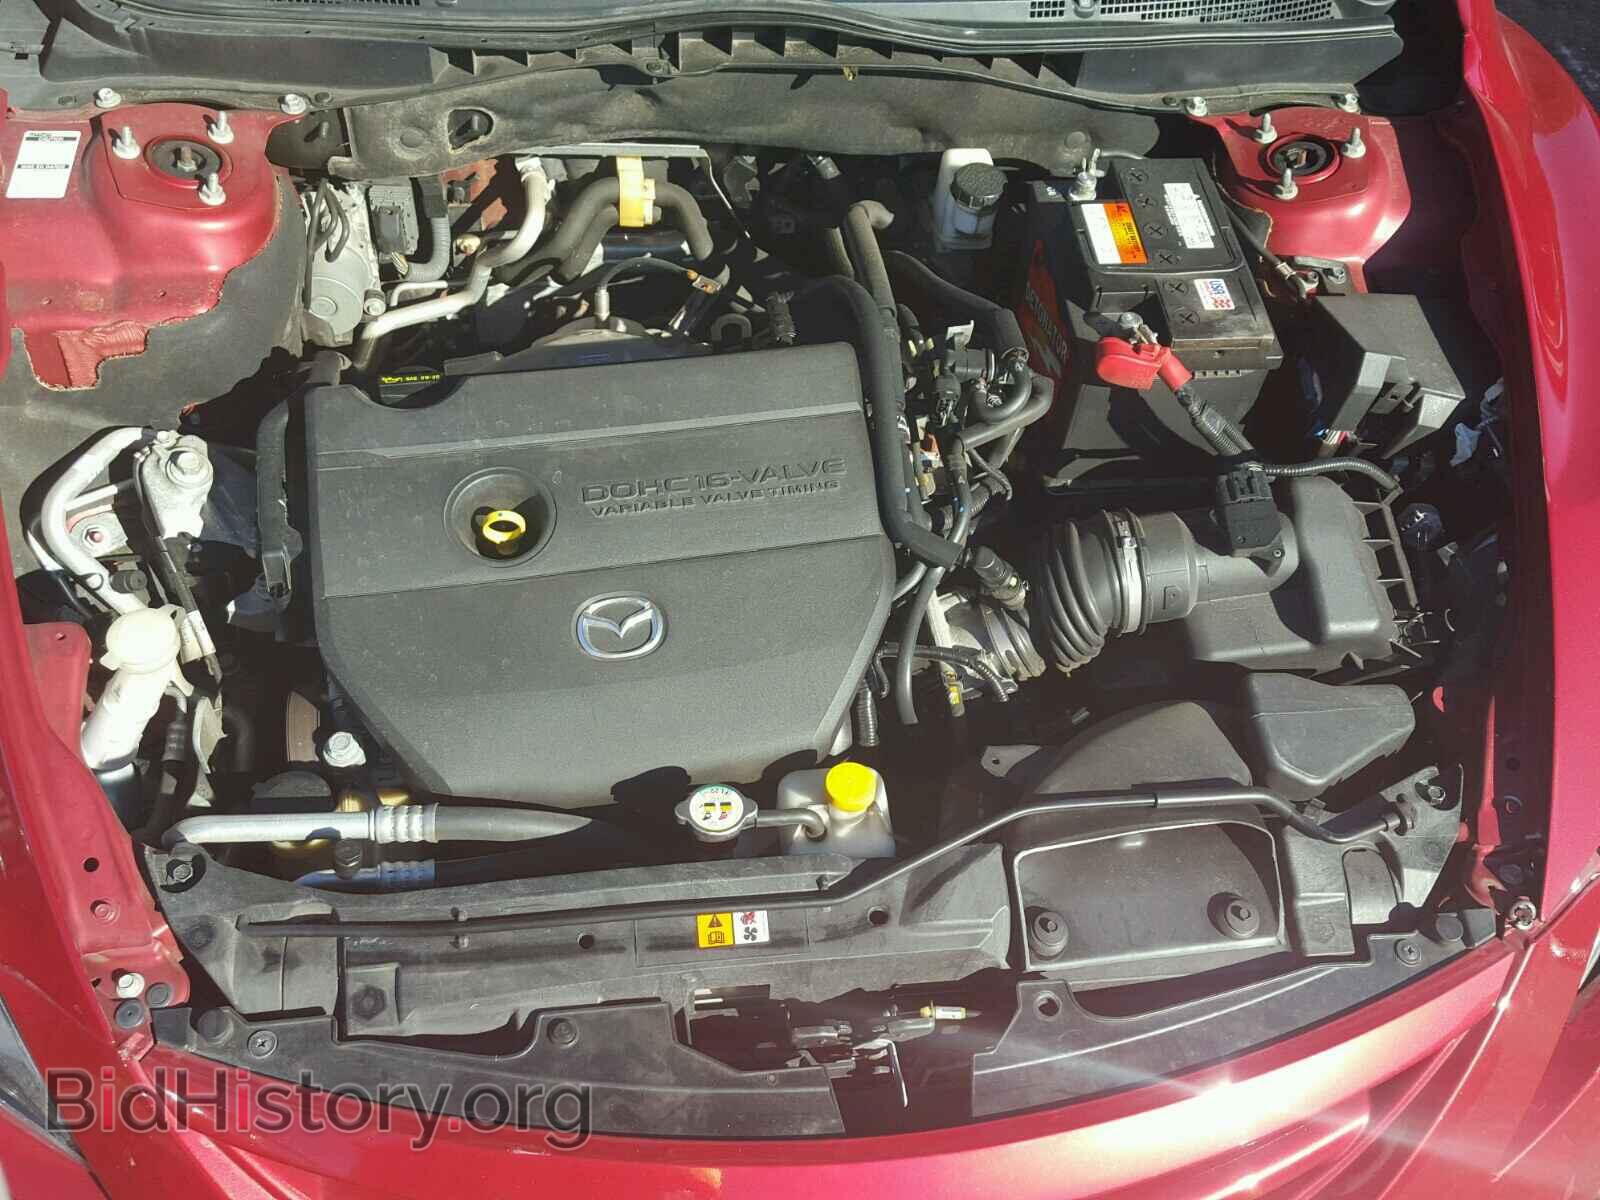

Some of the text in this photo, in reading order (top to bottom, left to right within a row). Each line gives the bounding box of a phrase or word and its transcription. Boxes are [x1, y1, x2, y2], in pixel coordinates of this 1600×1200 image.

[581, 457, 847, 504] DOHC 16-VALVE
[591, 479, 841, 518] VARIABLE VALVE TIMING
